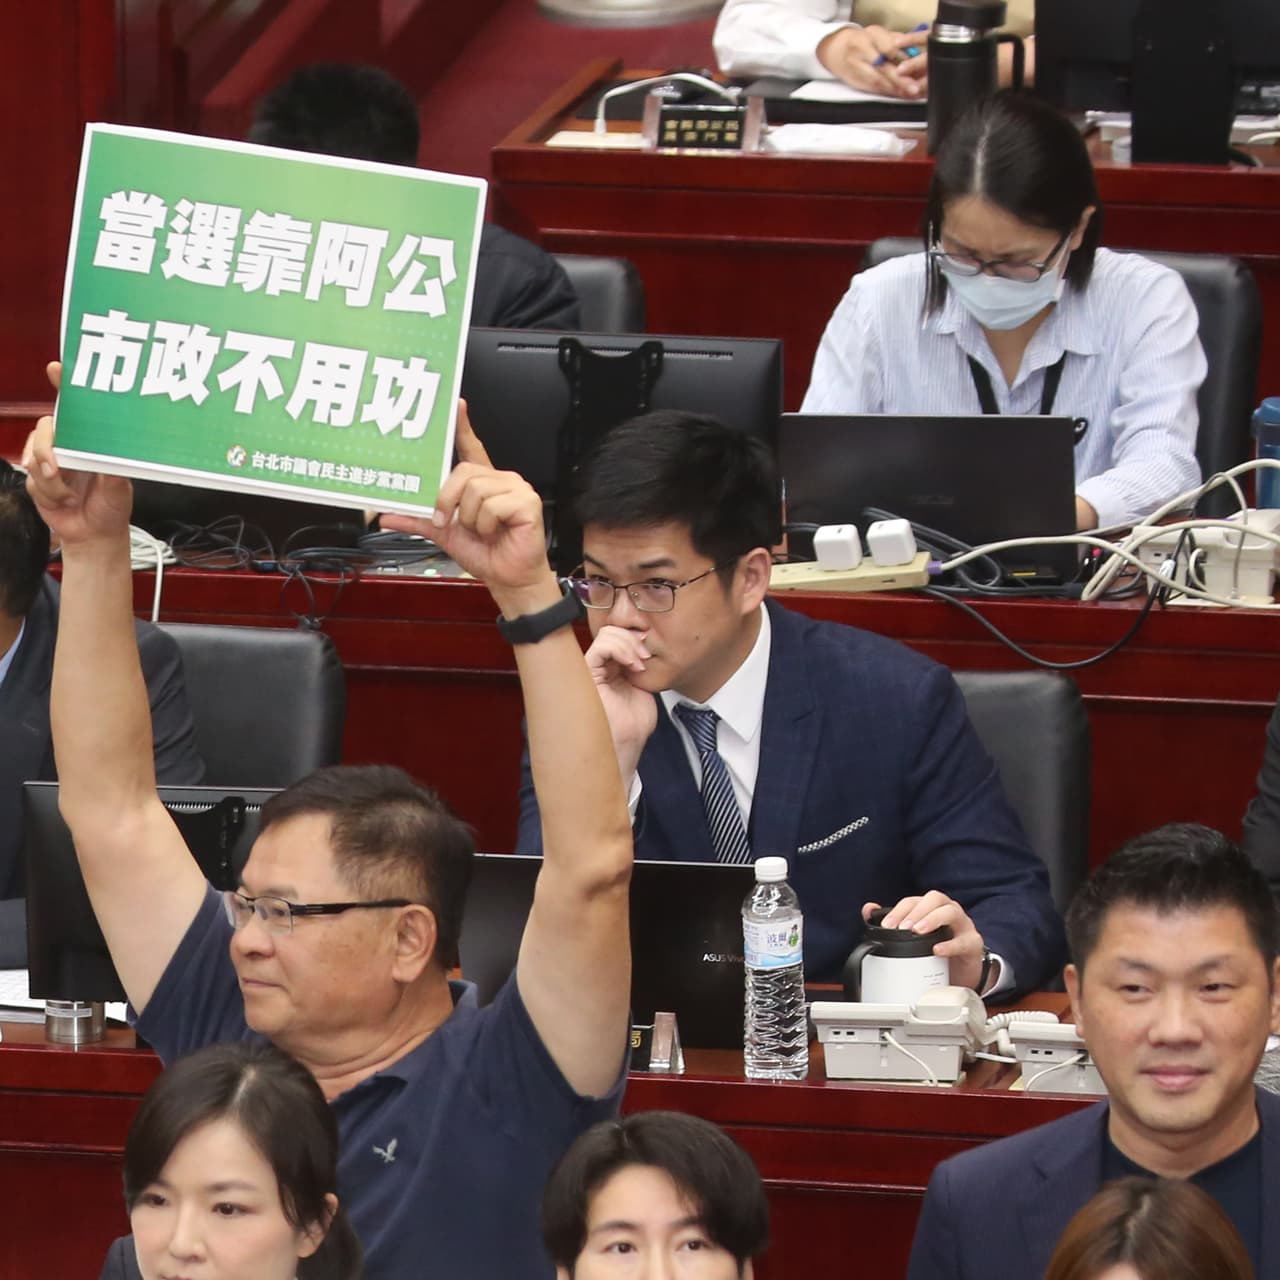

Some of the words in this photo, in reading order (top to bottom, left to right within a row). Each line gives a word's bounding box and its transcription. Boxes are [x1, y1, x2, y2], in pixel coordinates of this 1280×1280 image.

[93, 191, 457, 318] 當選靠阿公
[71, 309, 441, 439] 市政不用功
[252, 452, 421, 492] 台北市議會民主進步黨黨團
